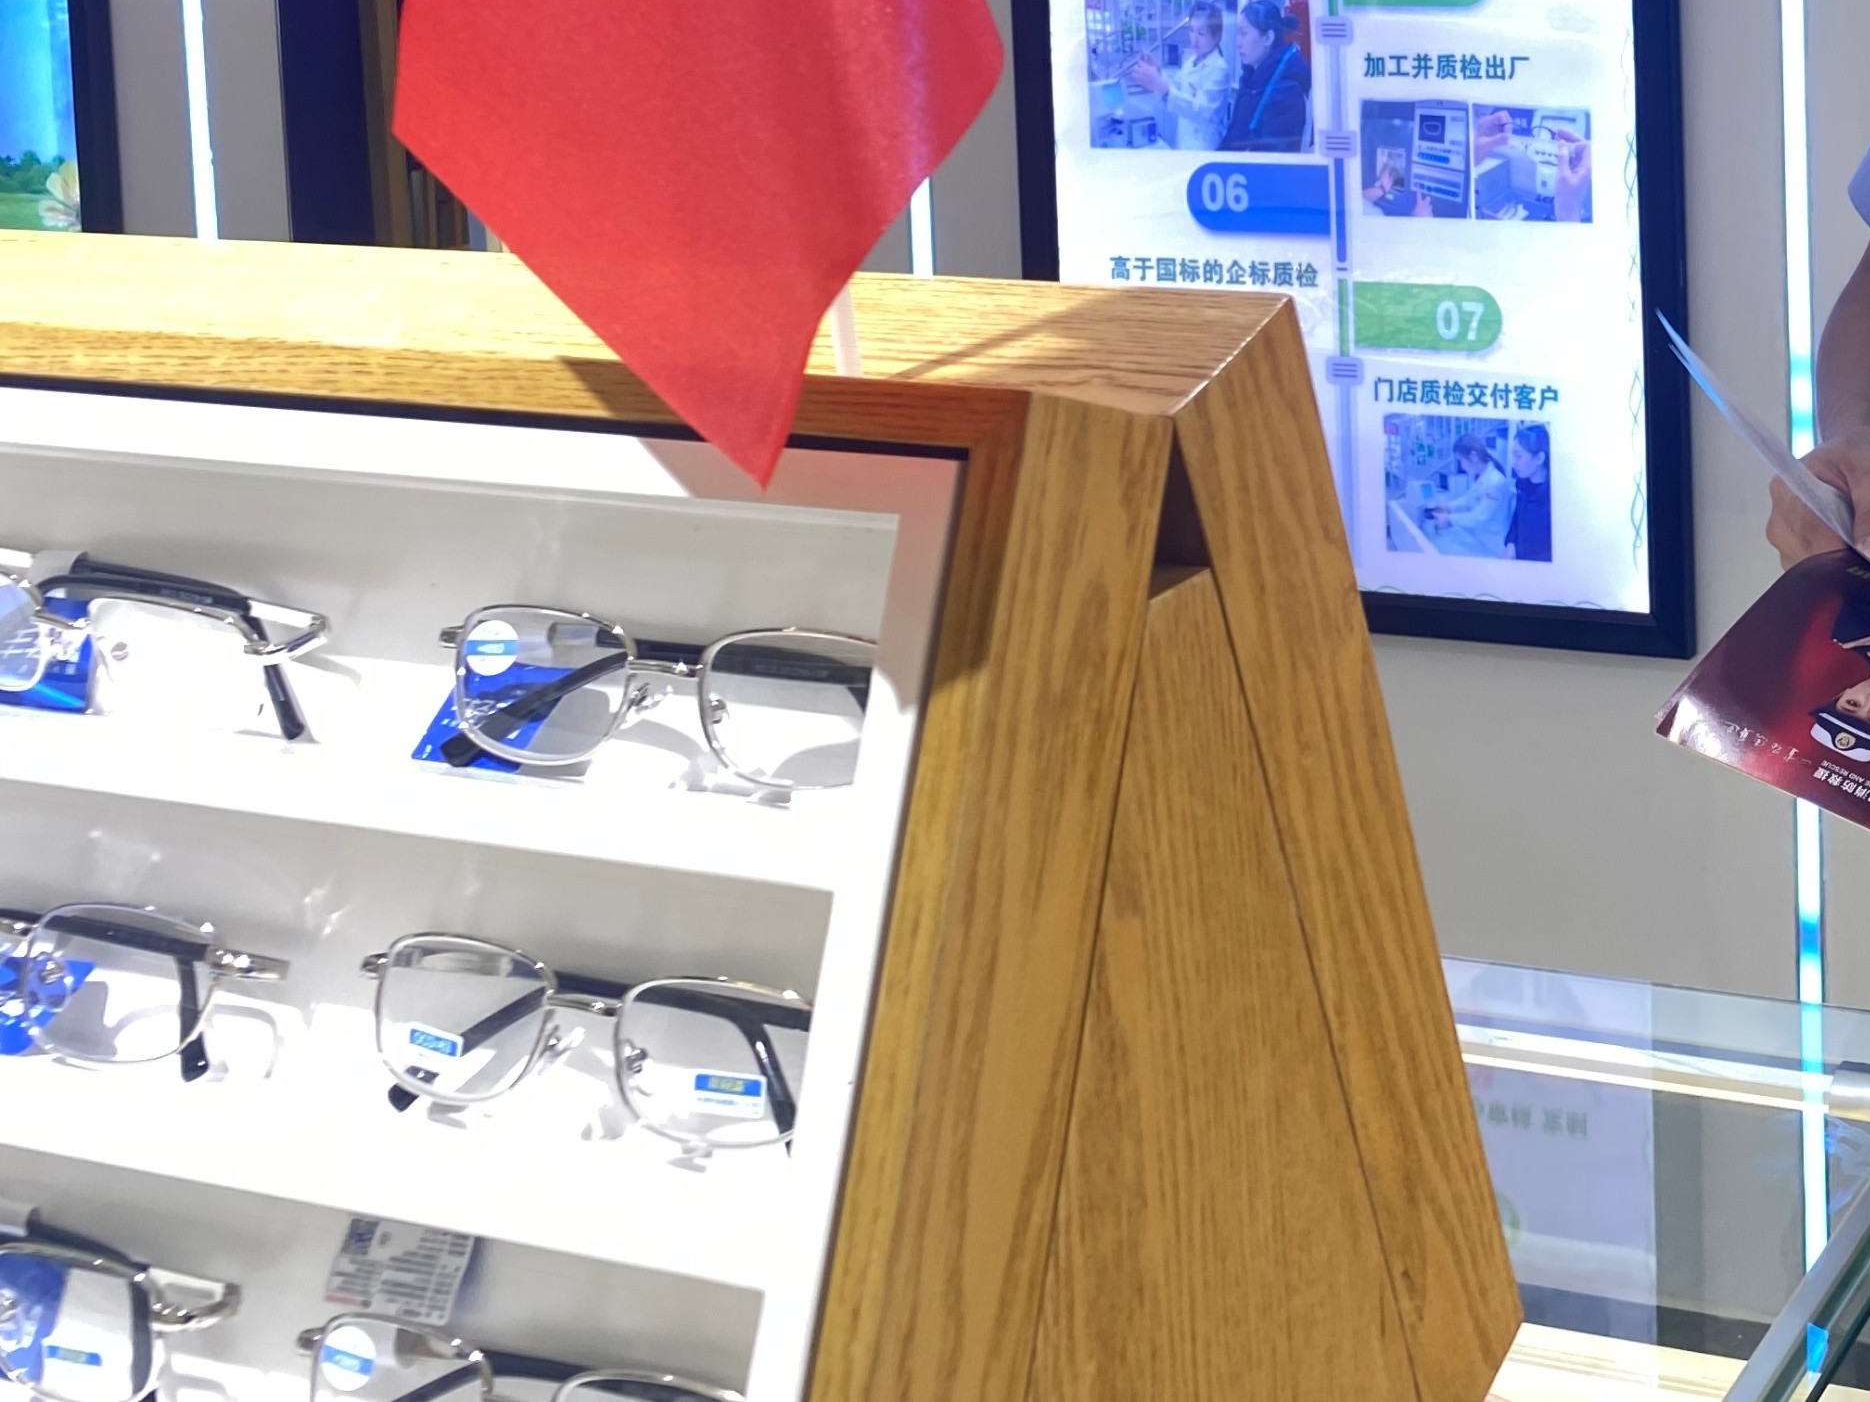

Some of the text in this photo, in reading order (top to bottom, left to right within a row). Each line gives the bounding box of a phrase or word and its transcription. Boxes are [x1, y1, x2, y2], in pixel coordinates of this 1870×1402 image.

[1363, 52, 1531, 82] 加工并质检出厂
[1200, 173, 1250, 211] 06
[1110, 254, 1319, 288] 高于国标的企标质检
[1435, 301, 1484, 340] 07
[1373, 377, 1560, 412] 门店质检交付客户
